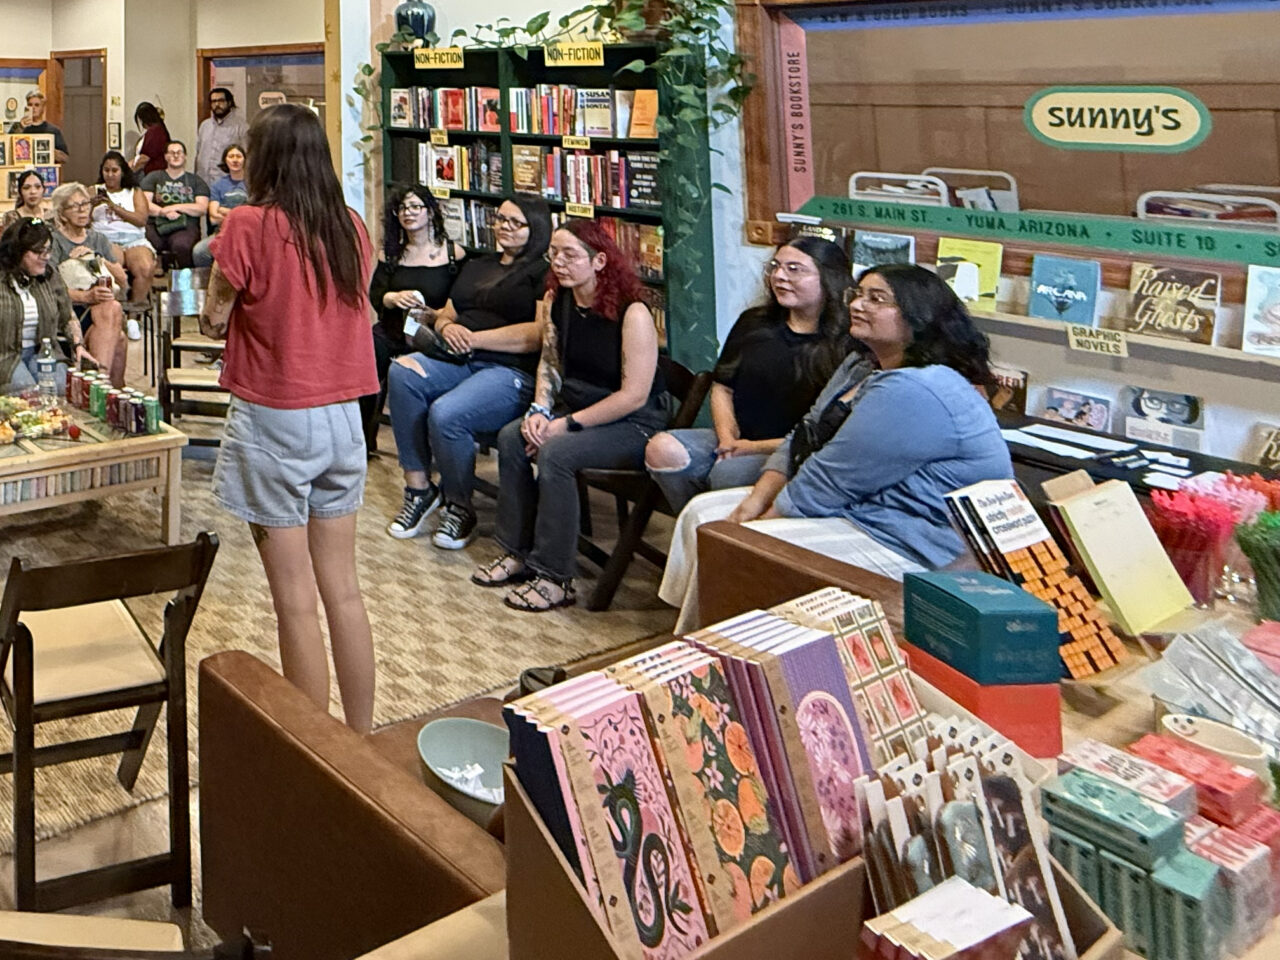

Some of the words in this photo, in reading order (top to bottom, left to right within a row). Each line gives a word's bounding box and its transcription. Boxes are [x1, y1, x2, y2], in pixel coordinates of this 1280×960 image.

[415, 51, 462, 64] NON-FICTION
[547, 47, 601, 61] NON-FICTION
[787, 52, 804, 118] BOOKSTORE
[1048, 105, 1181, 136] sunny's
[791, 123, 807, 173] SUNNY'S
[832, 202, 854, 216] 261
[858, 204, 869, 218] S.
[874, 206, 905, 222] MAIN
[911, 209, 933, 224] ST.
[1019, 220, 1091, 239] ARIZONA
[1132, 229, 1187, 249] SUITE
[1196, 235, 1216, 251] 10
[1036, 284, 1087, 302] ARCANA
[1135, 265, 1217, 301] Raised
[1128, 296, 1206, 332] Ghosts
[1072, 326, 1121, 343] GRAPHIC
[1075, 338, 1121, 354] NOVELS
